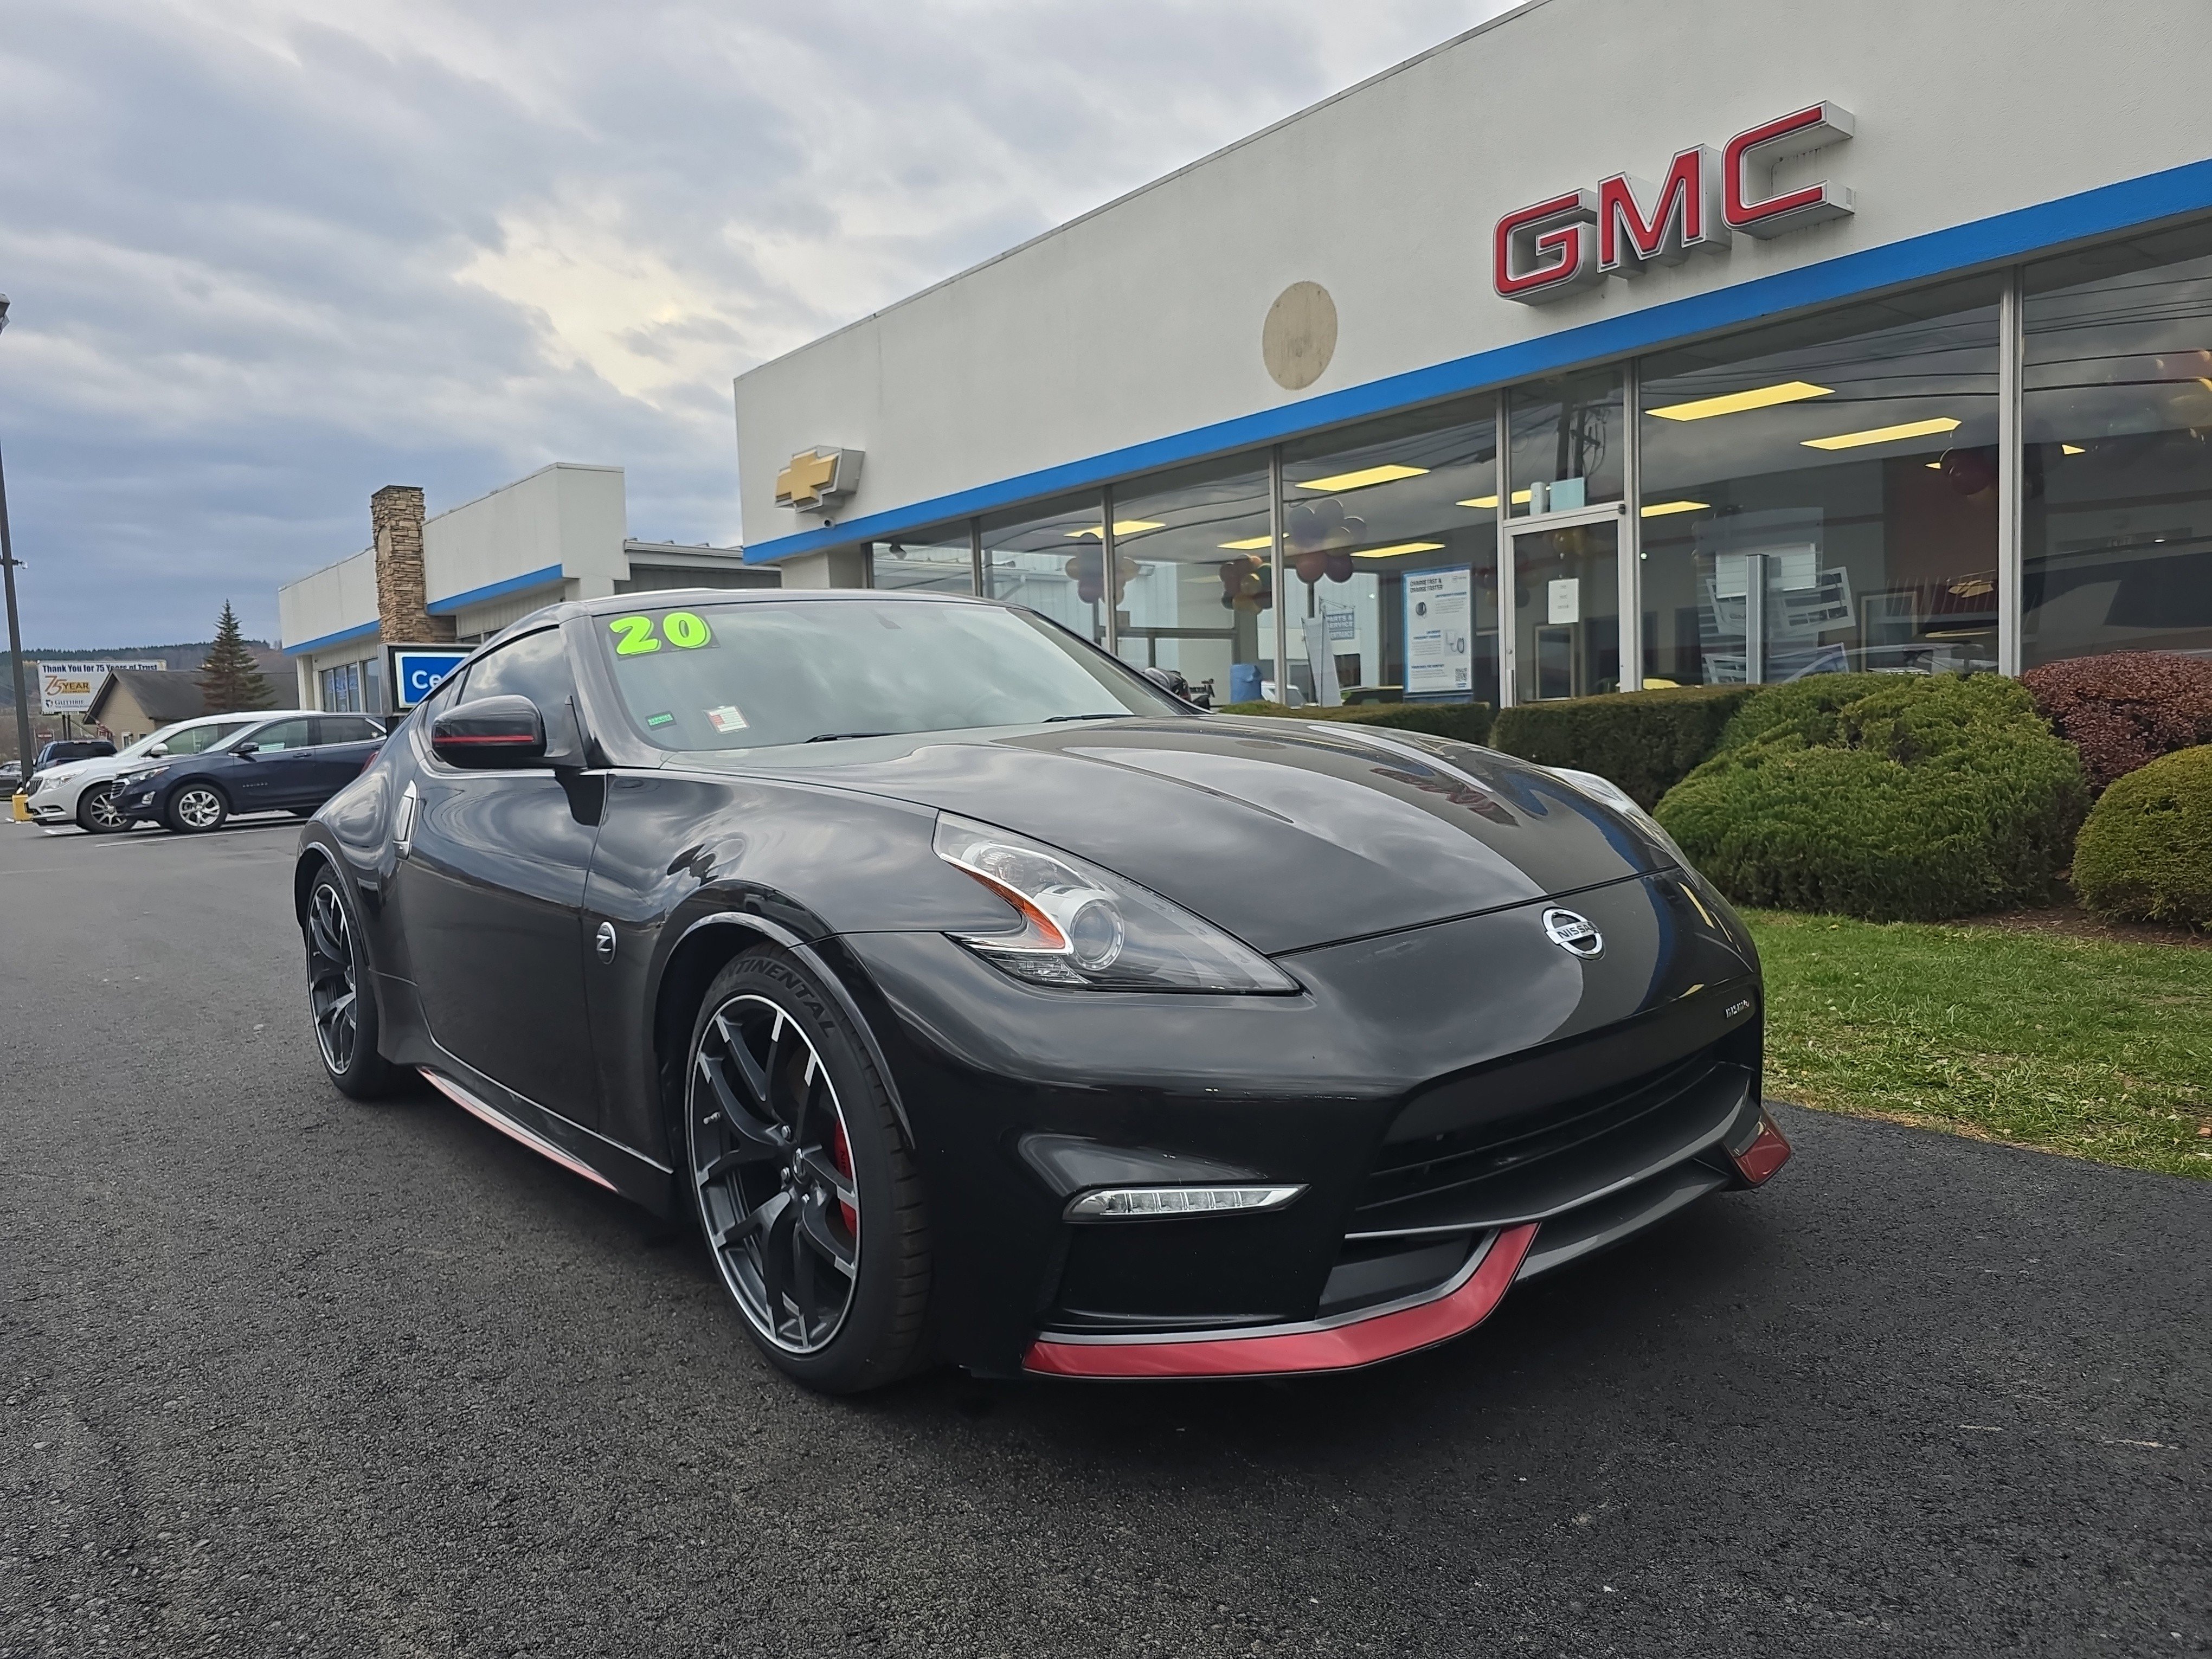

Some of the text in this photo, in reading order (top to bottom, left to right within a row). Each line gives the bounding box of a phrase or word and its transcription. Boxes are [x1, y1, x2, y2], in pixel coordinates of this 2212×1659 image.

[1493, 100, 1830, 300] GMC
[609, 612, 711, 655] 20
[43, 664, 66, 672] Thank
[68, 664, 82, 672] You
[45, 676, 67, 696] 75
[62, 682, 89, 690] YEAR
